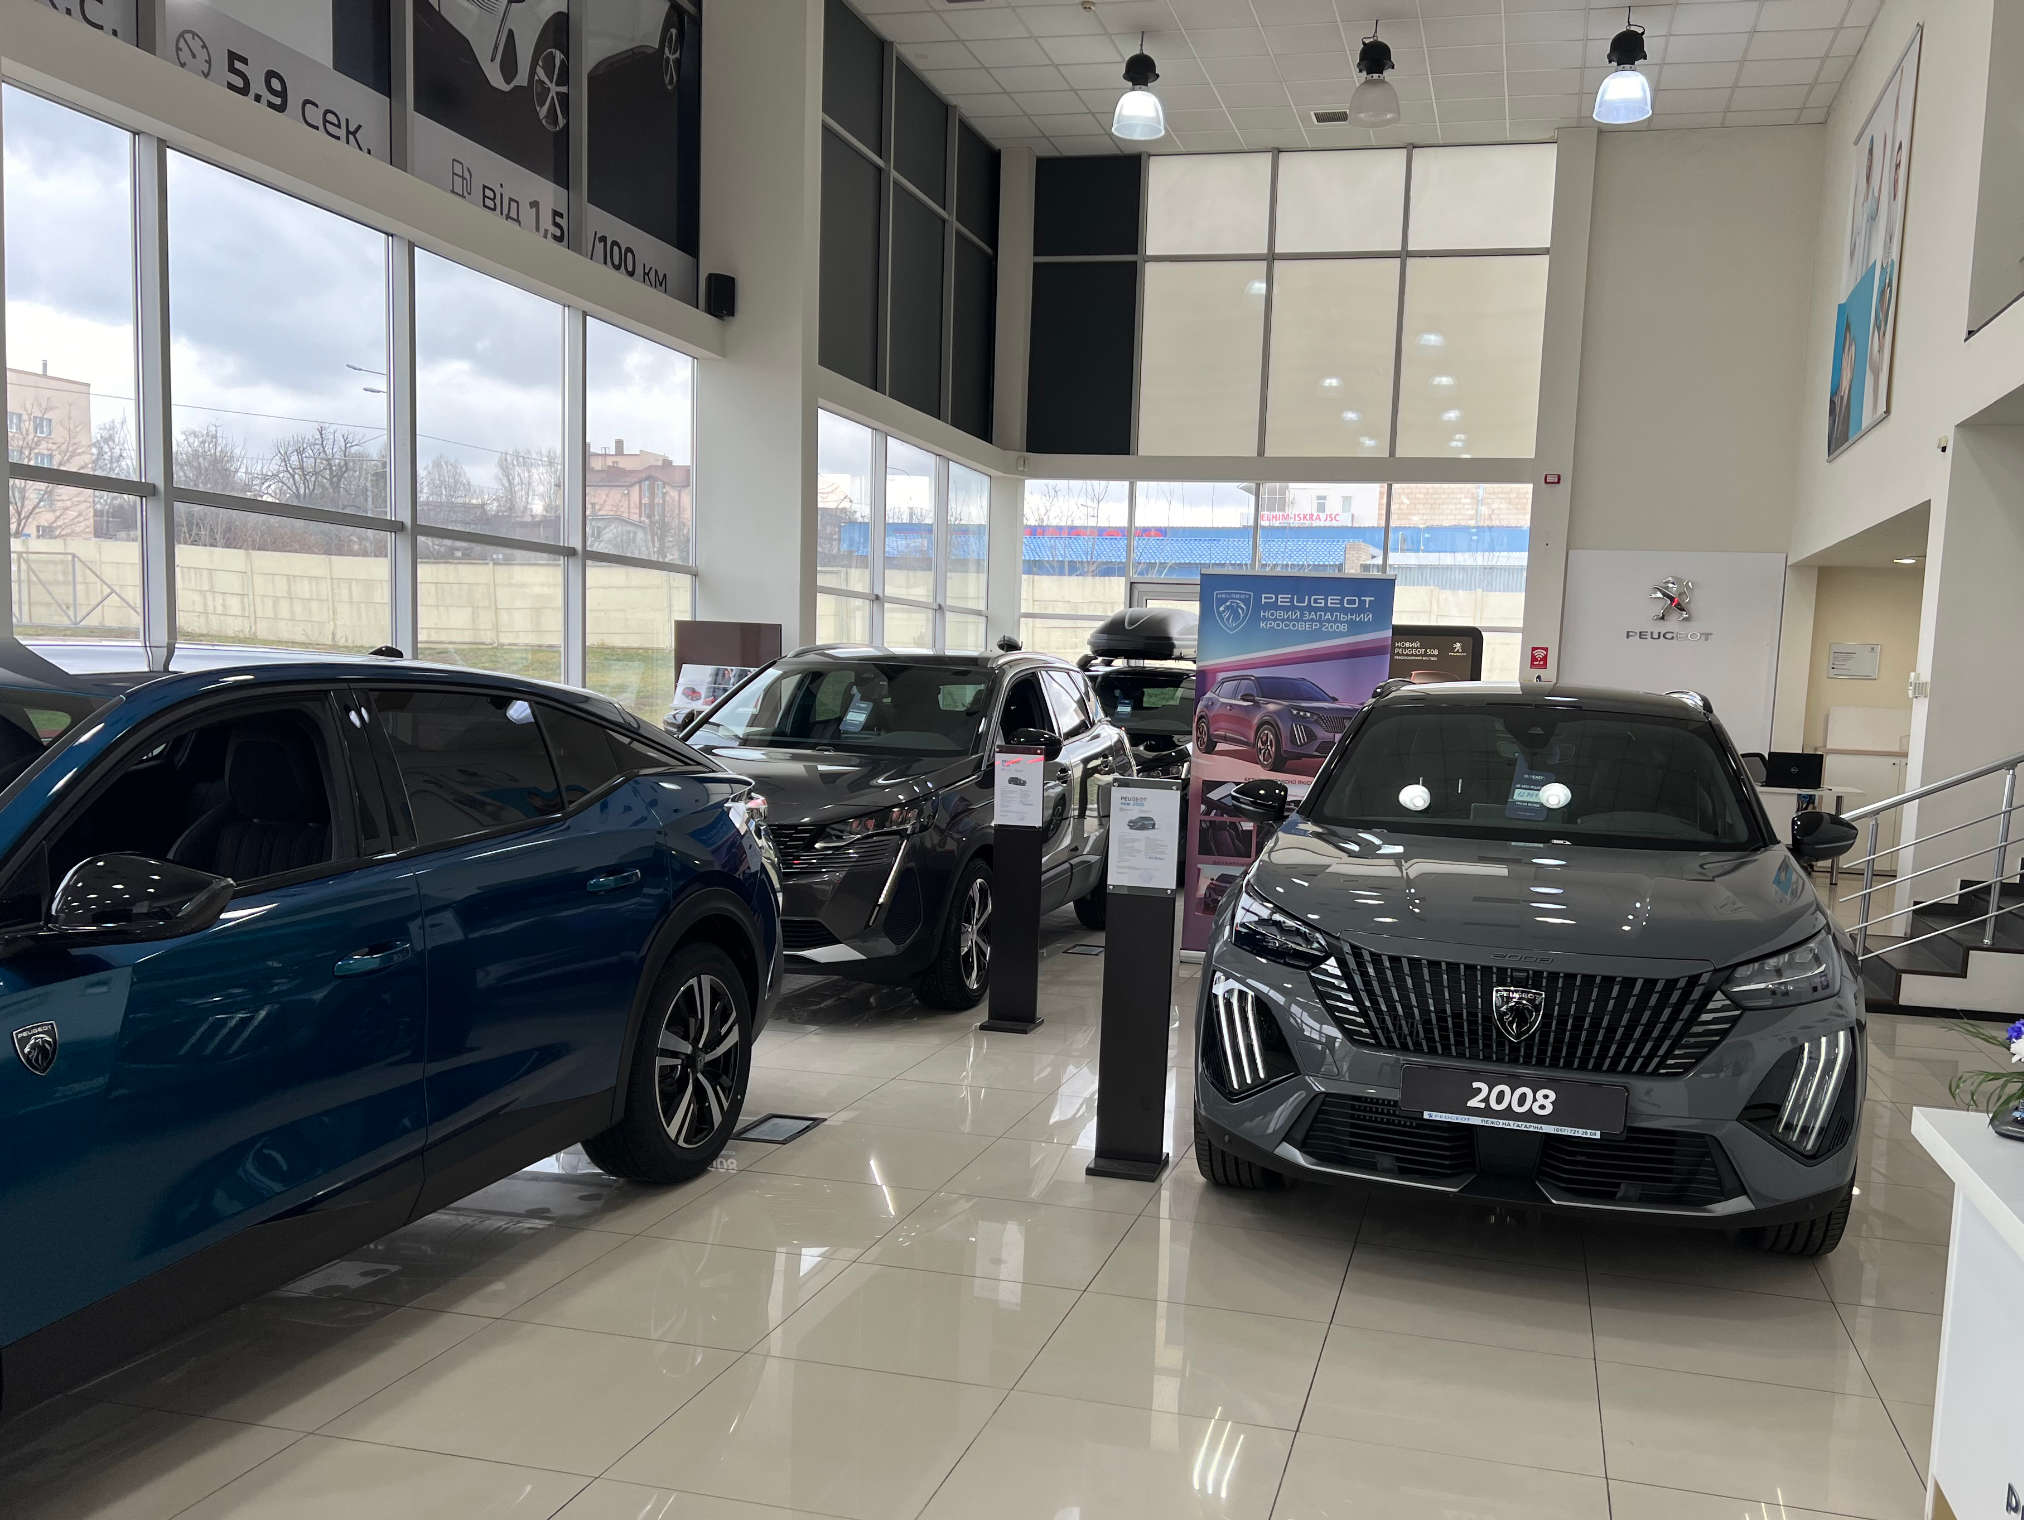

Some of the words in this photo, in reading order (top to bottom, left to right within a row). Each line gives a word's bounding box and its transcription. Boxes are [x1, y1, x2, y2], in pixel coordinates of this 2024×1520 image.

[300, 98, 372, 155] сек.
[482, 183, 522, 227] від
[528, 200, 565, 243] 1,5
[642, 263, 668, 293] км
[1324, 513, 1340, 522] JSC
[1261, 593, 1375, 609] PEUGEOT
[1260, 609, 1300, 620] НОВИЙ
[1303, 611, 1373, 622] ЗАПАЛЬНИЙ
[1260, 621, 1320, 631] КРОСОВЕР
[1322, 622, 1348, 632] 2008
[1625, 630, 1713, 642] PEUGEOT
[1395, 640, 1420, 648] НОВИЙ
[1394, 647, 1426, 655] PEUGEOT
[17, 1024, 52, 1039] PEUGEOT
[1466, 1081, 1556, 1116] 2008
